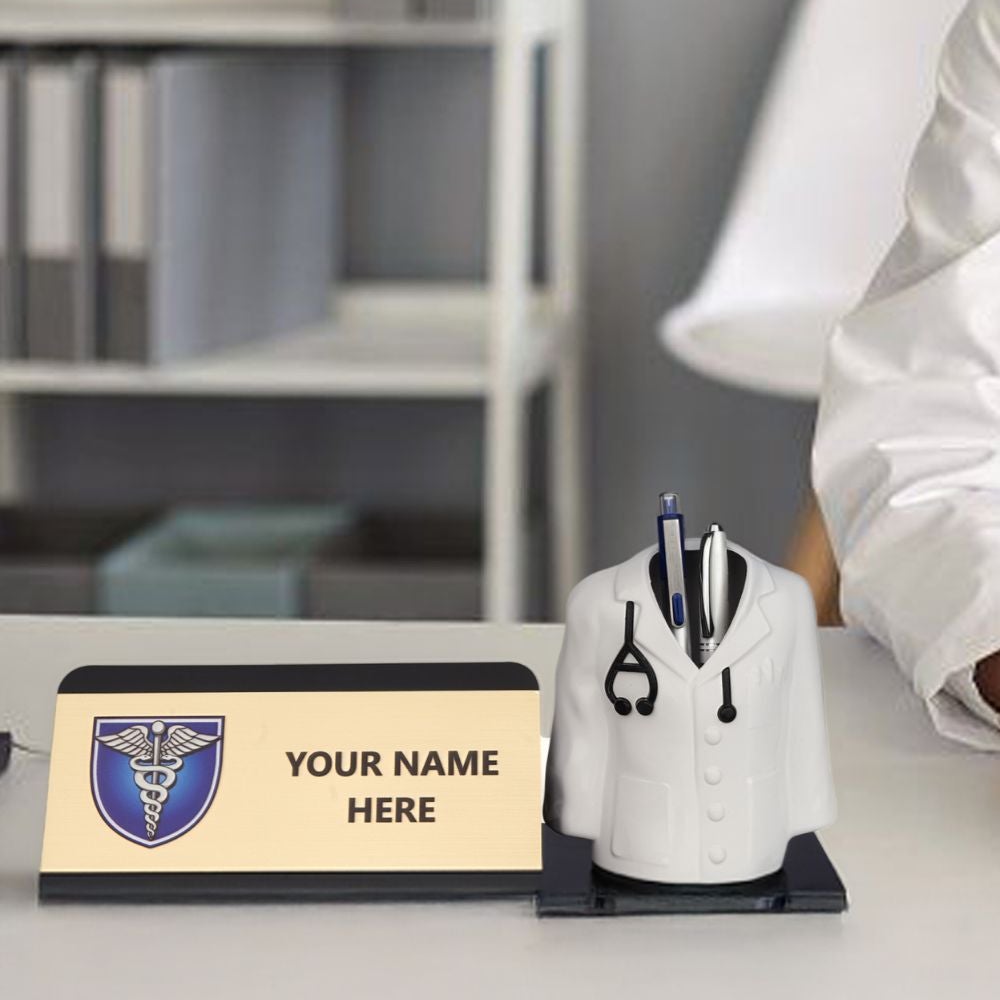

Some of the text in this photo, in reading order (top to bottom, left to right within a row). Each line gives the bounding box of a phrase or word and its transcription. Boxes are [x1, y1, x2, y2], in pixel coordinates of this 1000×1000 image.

[285, 750, 499, 777] YOUR NAME
[348, 796, 436, 824] HERE
